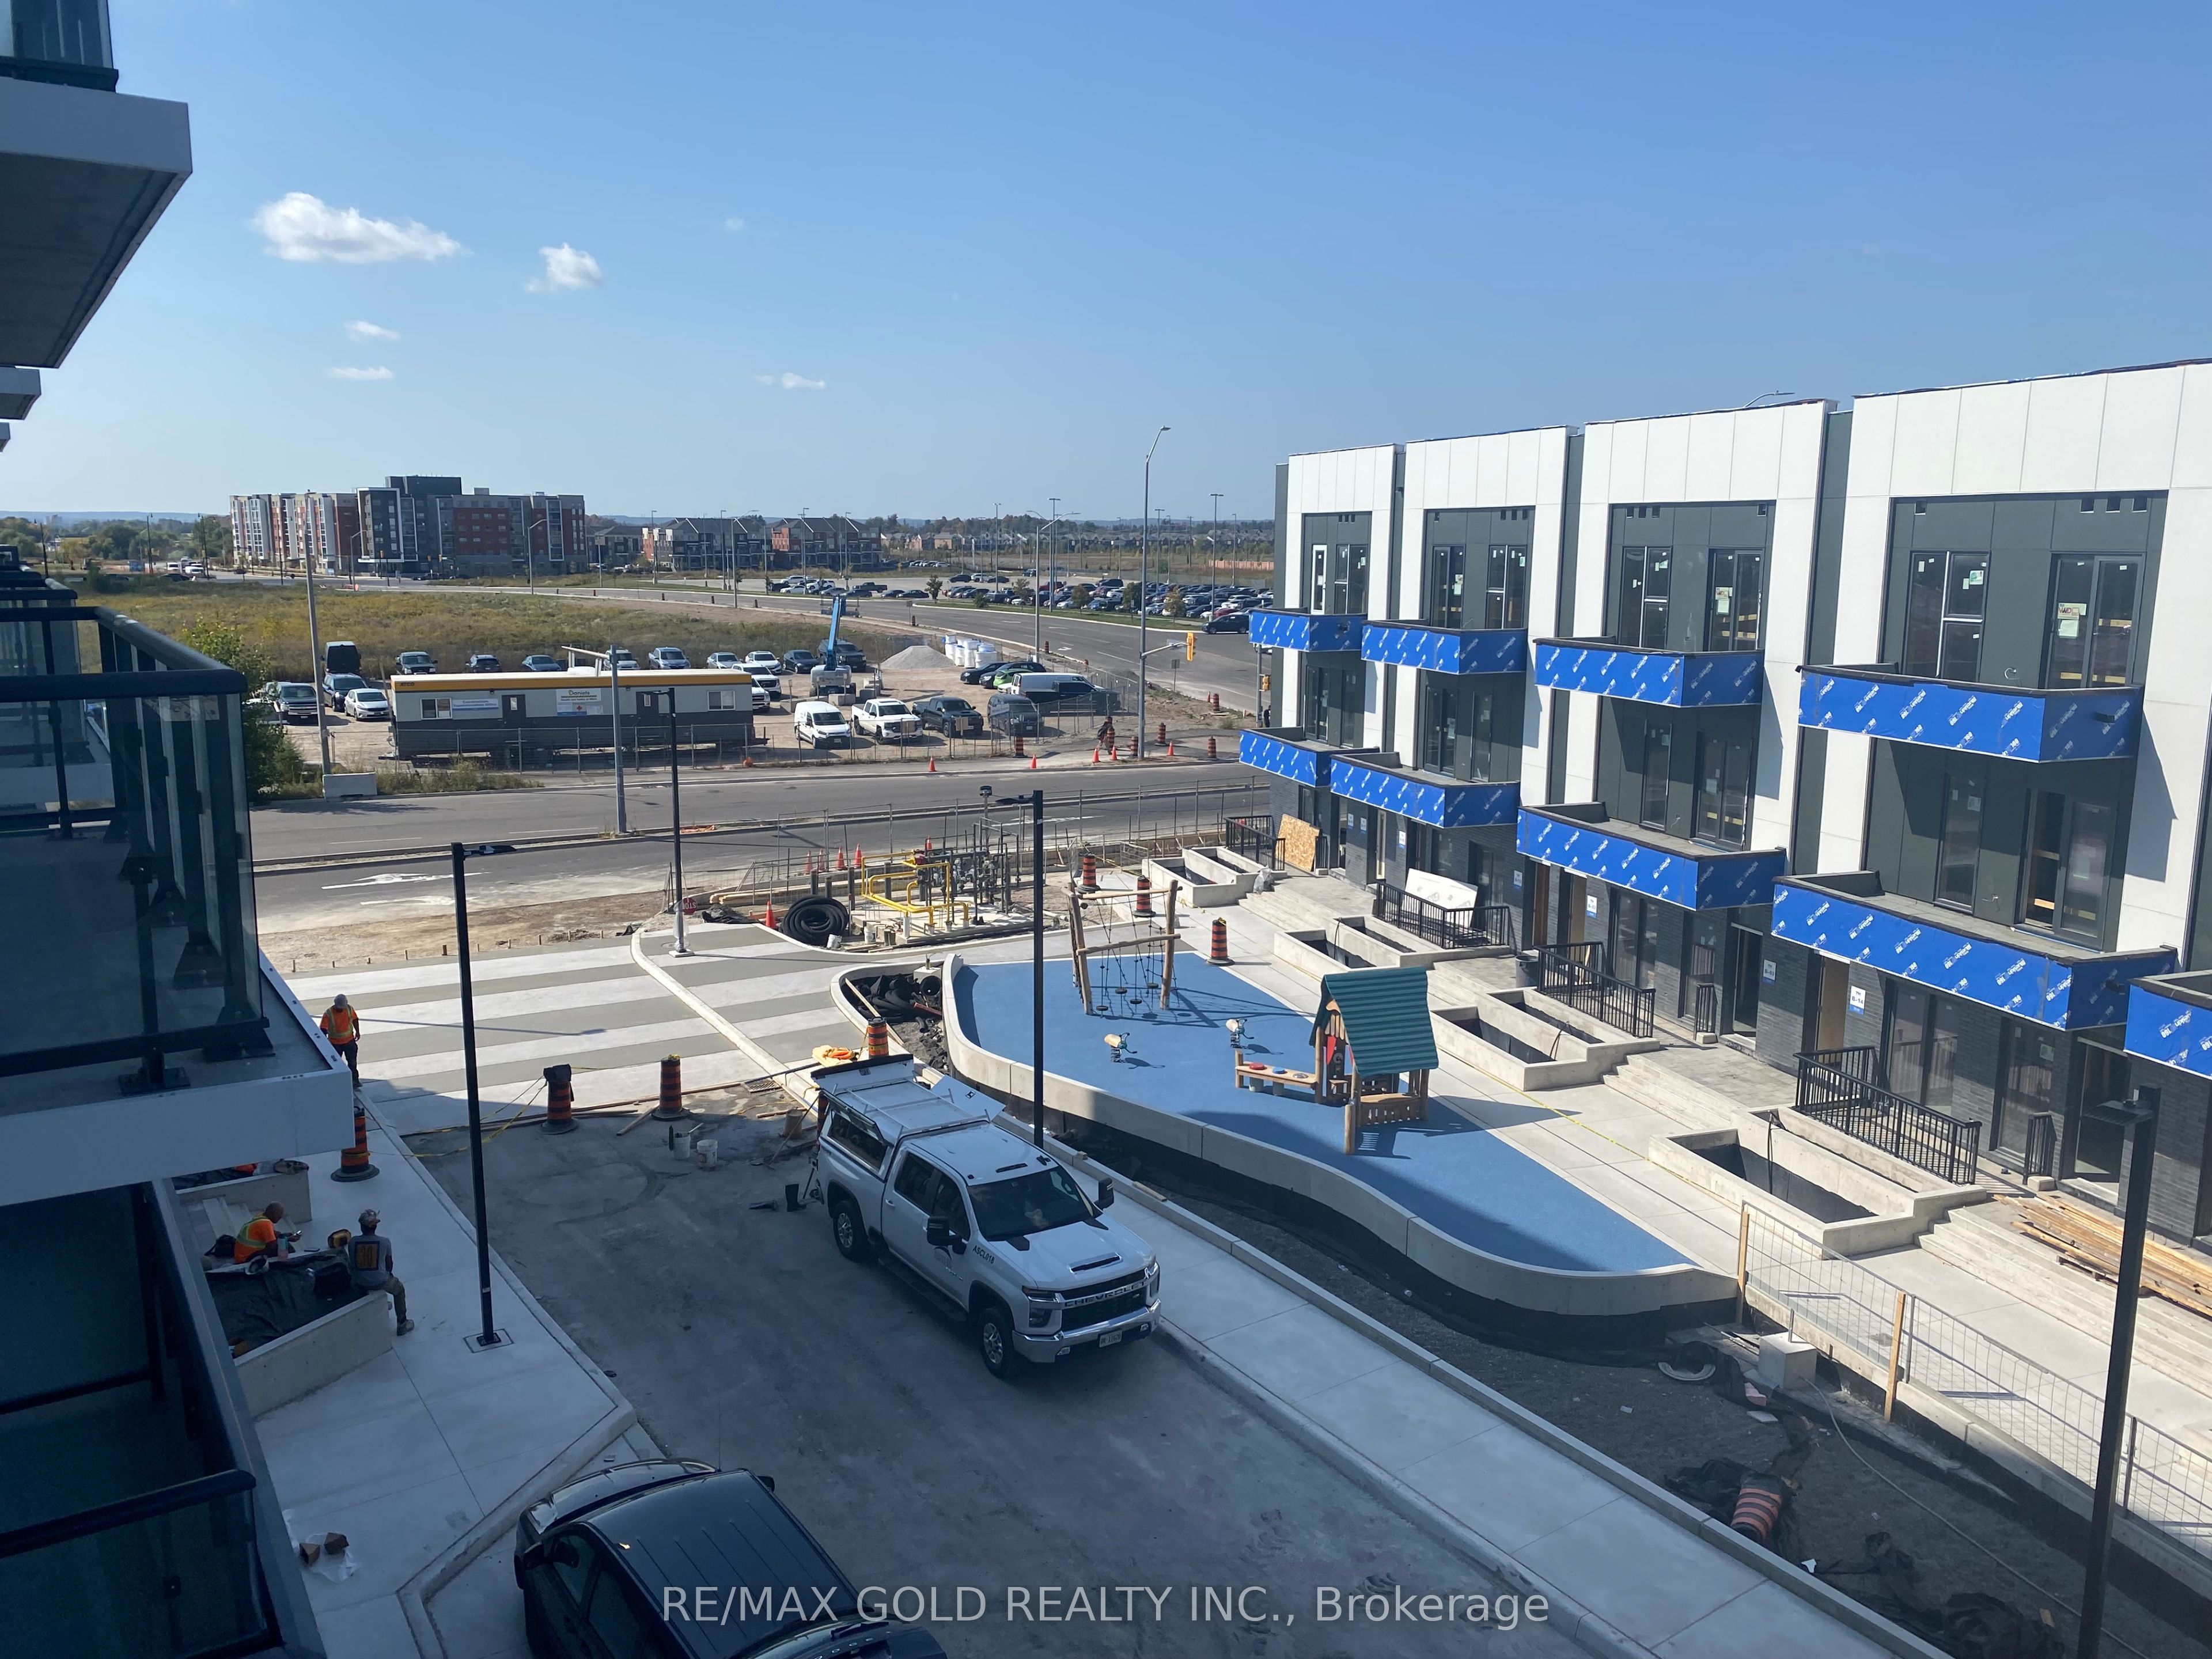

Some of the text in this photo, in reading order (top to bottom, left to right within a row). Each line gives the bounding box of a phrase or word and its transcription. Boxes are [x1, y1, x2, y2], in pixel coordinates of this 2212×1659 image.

[1851, 995, 1864, 1004] B-14
[972, 1245, 995, 1264] ASCL018
[1065, 1282, 1146, 1307] CHEVROLET
